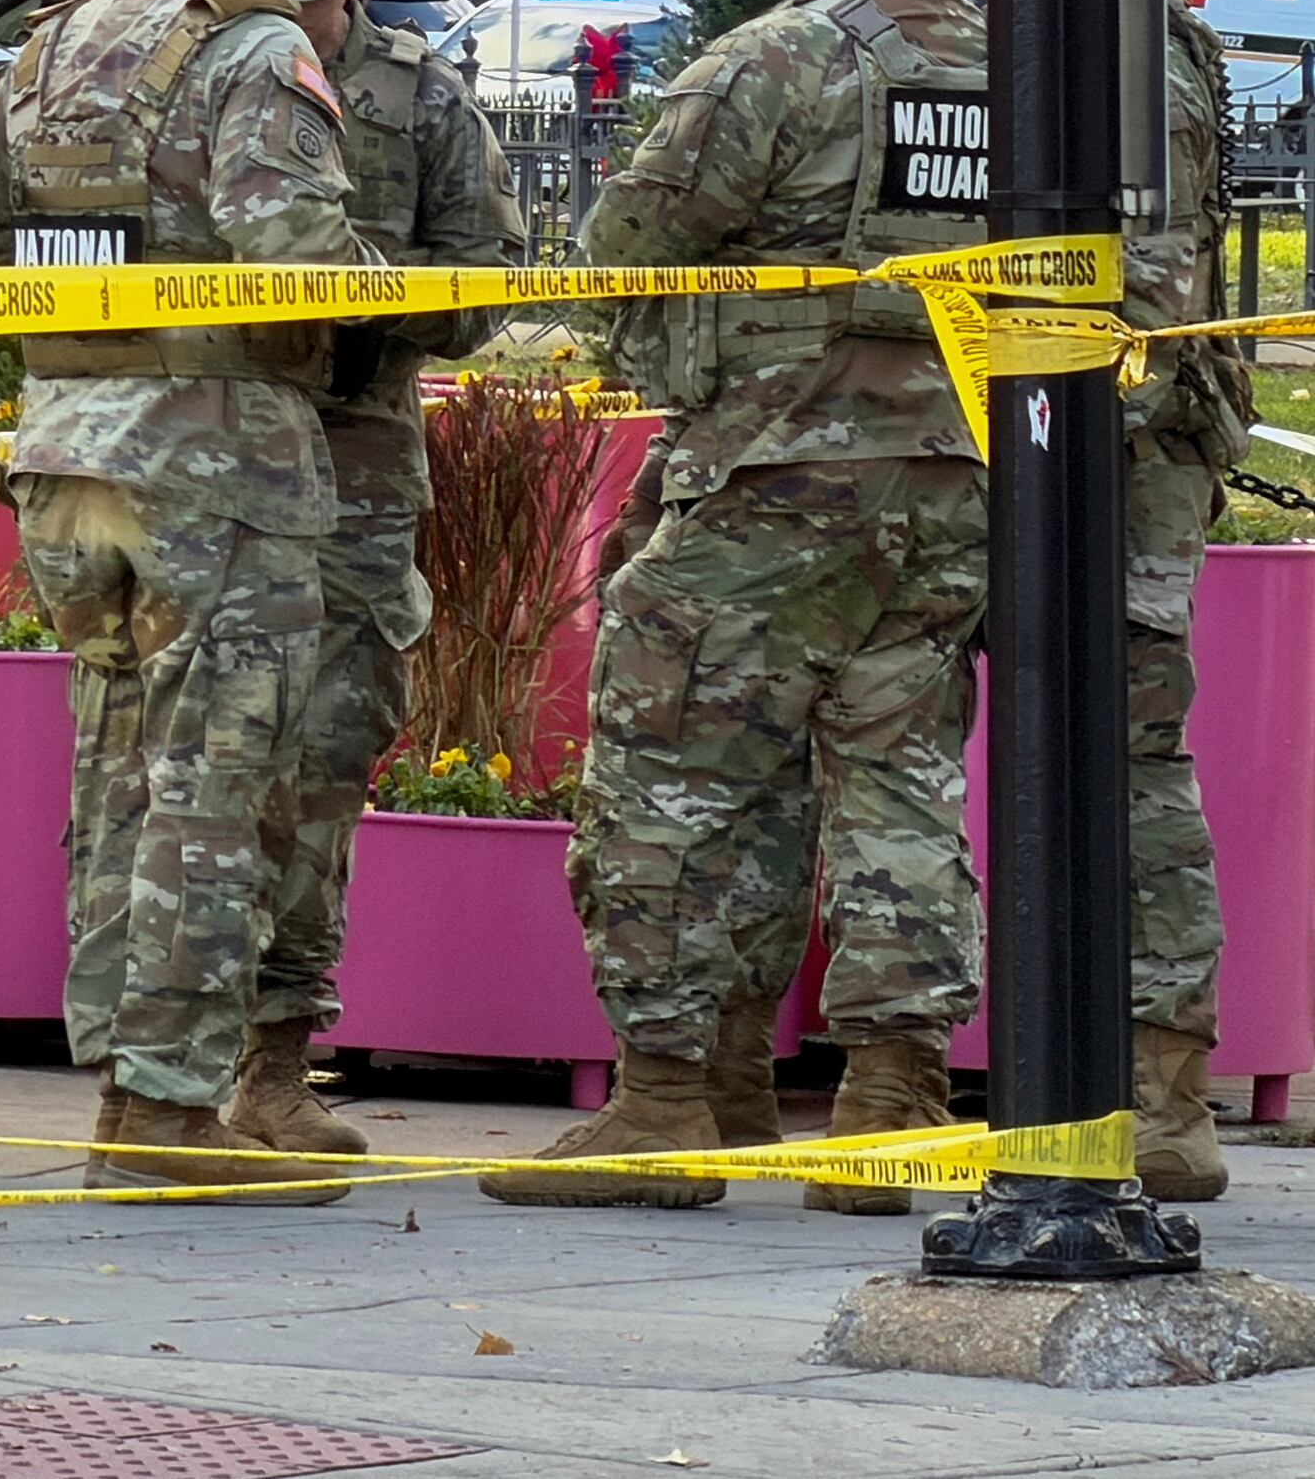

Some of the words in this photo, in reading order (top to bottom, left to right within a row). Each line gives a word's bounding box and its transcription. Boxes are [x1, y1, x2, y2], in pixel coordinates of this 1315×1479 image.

[894, 101, 988, 149] NATIO
[505, 270, 571, 298] POLICE
[576, 269, 617, 294] LINE
[622, 266, 649, 296] DO
[654, 266, 685, 295] NOT
[697, 265, 759, 293] CROSS
[971, 257, 994, 285] DO
[997, 253, 1038, 286] NOT
[1036, 245, 1096, 287] CROSS
[155, 274, 220, 311] POLICE
[225, 273, 266, 307] LINE
[272, 271, 296, 305] DO
[303, 271, 340, 304] NOT
[345, 270, 406, 303] CROSS
